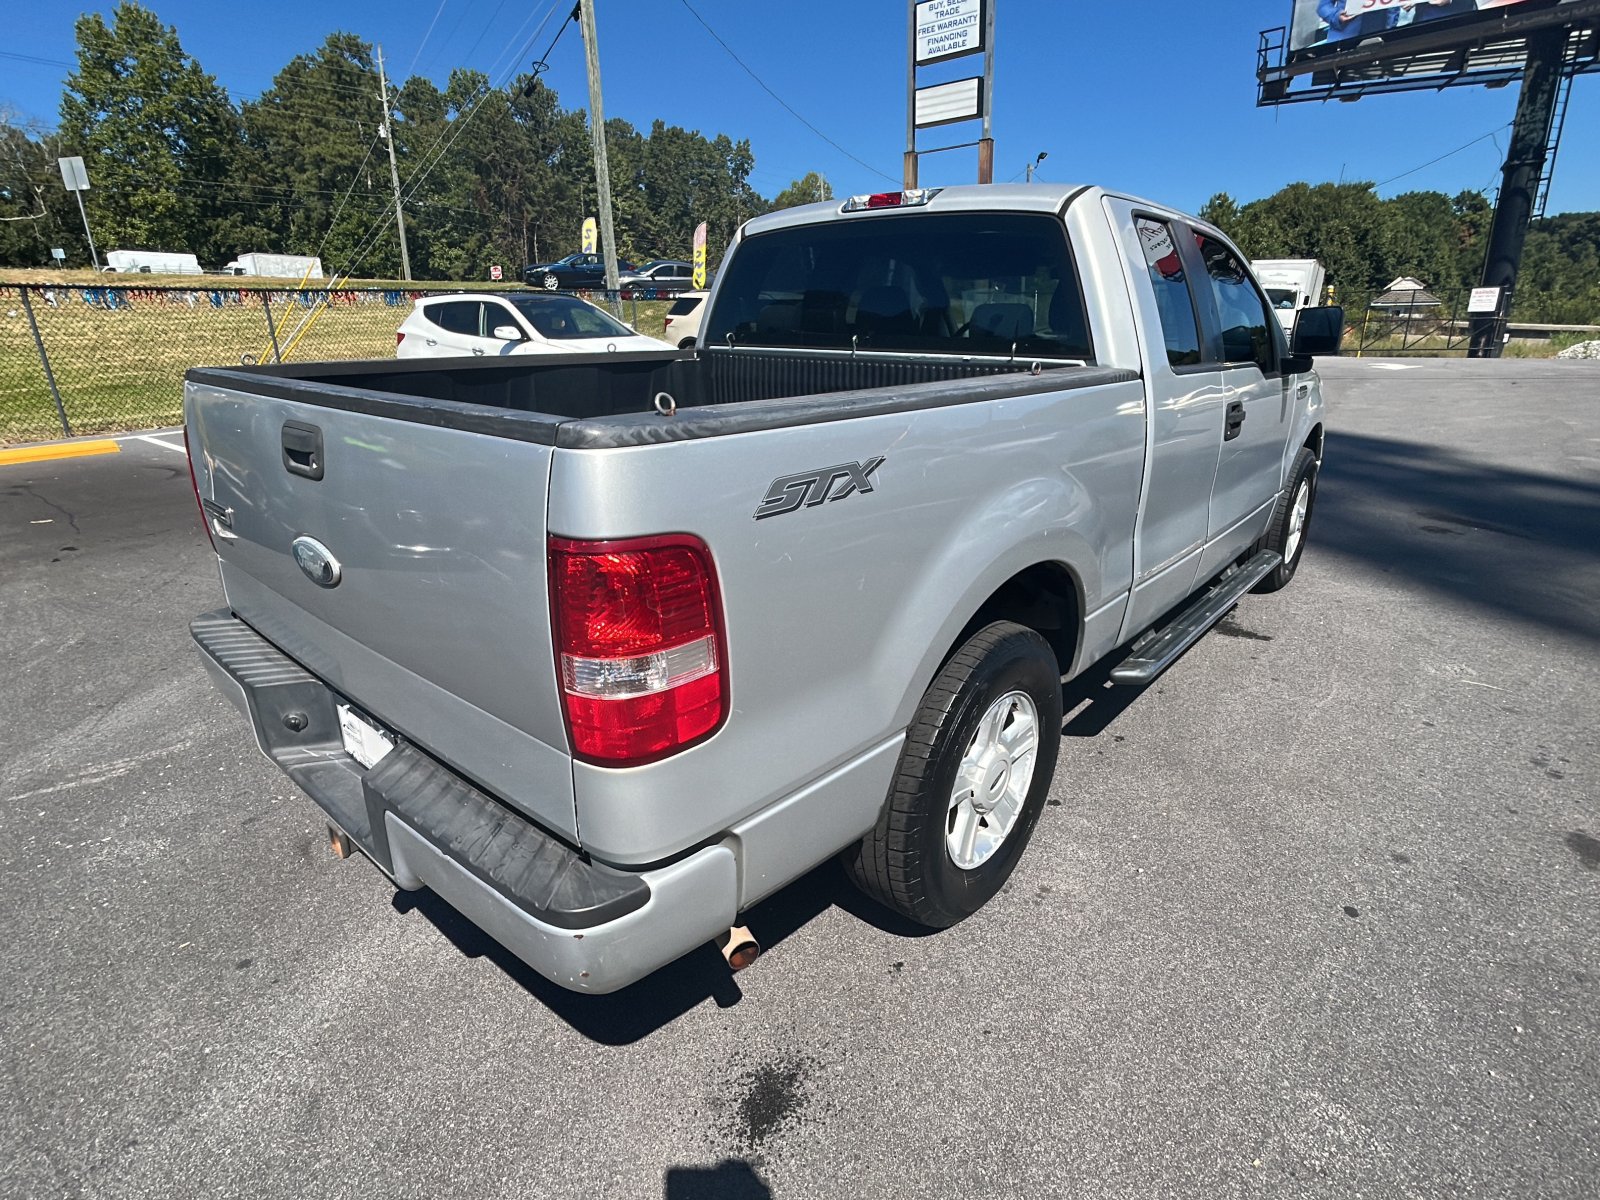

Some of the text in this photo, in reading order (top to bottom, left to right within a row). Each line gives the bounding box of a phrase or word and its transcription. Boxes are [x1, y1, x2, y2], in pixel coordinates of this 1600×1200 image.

[928, 1, 946, 12] BUY,
[935, 6, 961, 19] TRADE
[918, 14, 978, 36] FREE WARRANTY
[927, 30, 968, 46] FINANCING
[928, 40, 967, 55] AVAILABLE
[752, 455, 886, 520] STX
